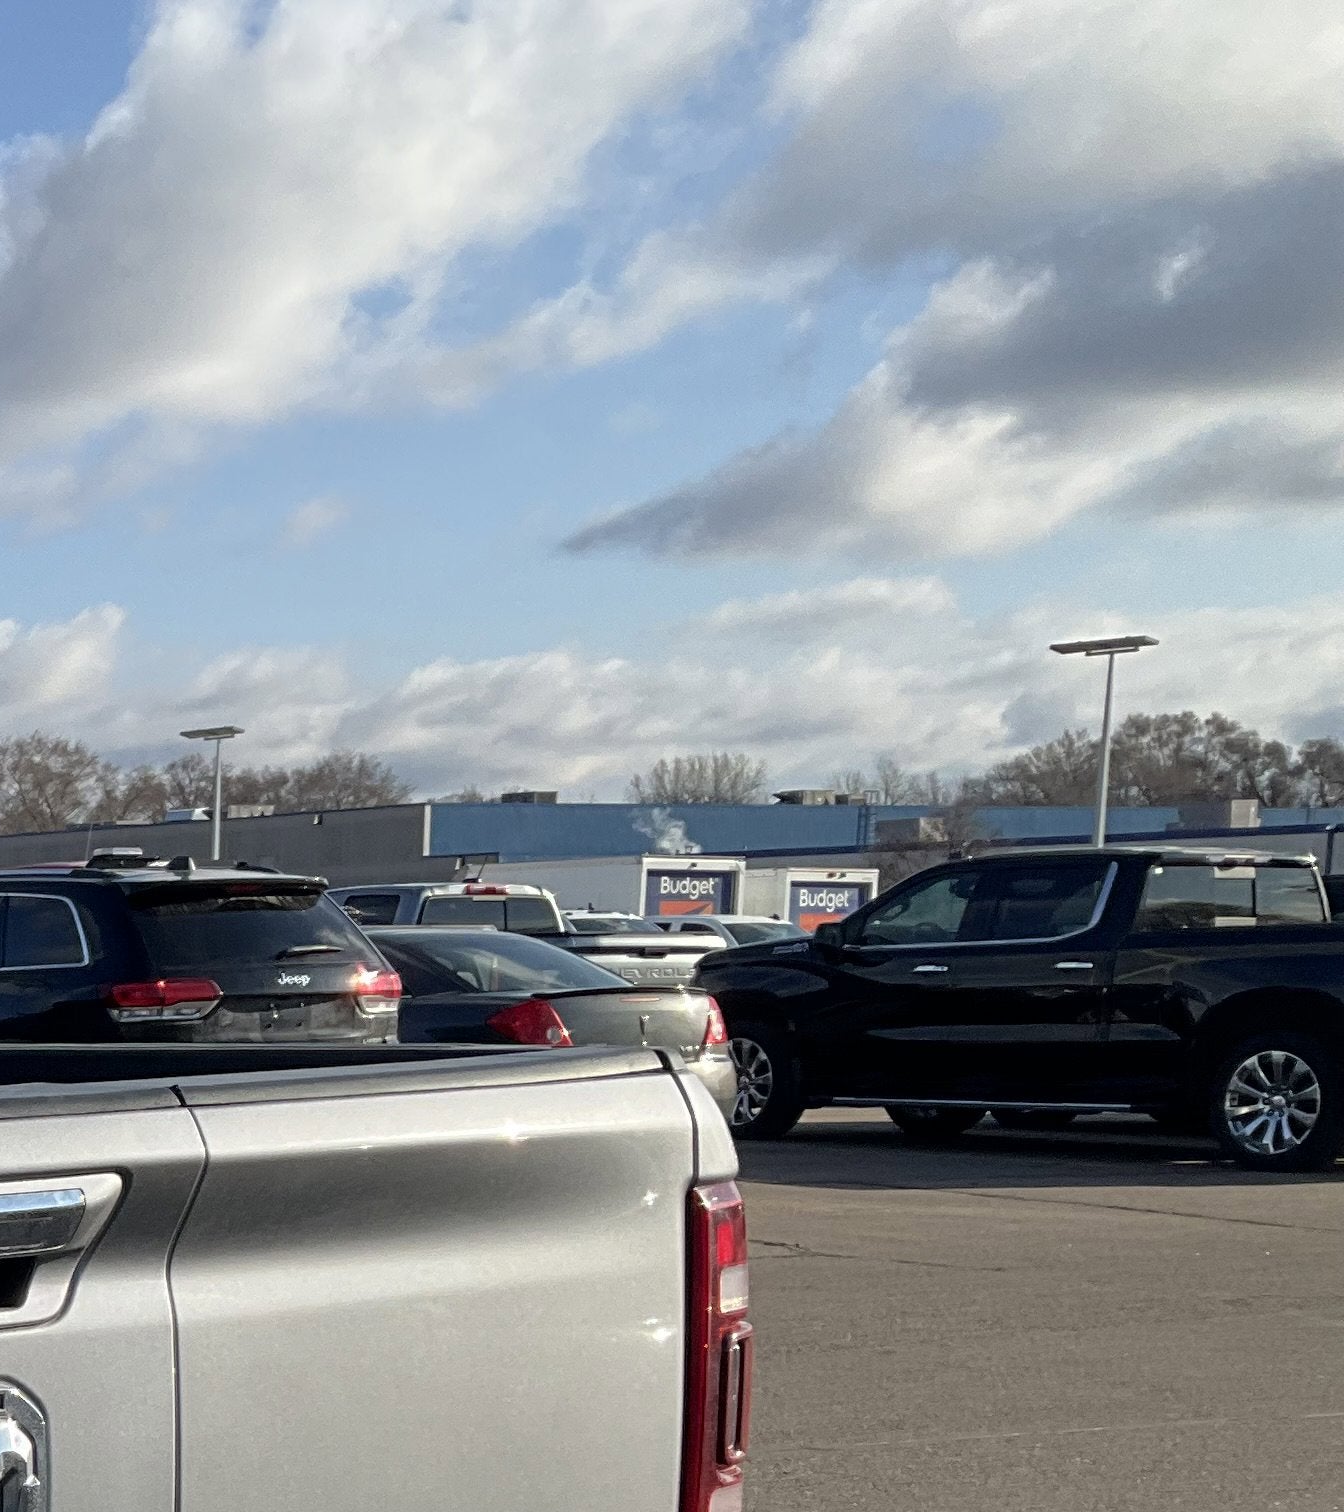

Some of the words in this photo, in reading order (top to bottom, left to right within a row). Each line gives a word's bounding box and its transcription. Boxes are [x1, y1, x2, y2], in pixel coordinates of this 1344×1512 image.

[659, 876, 715, 899] Budget
[799, 889, 850, 912] Budget
[278, 972, 310, 987] Jeep
